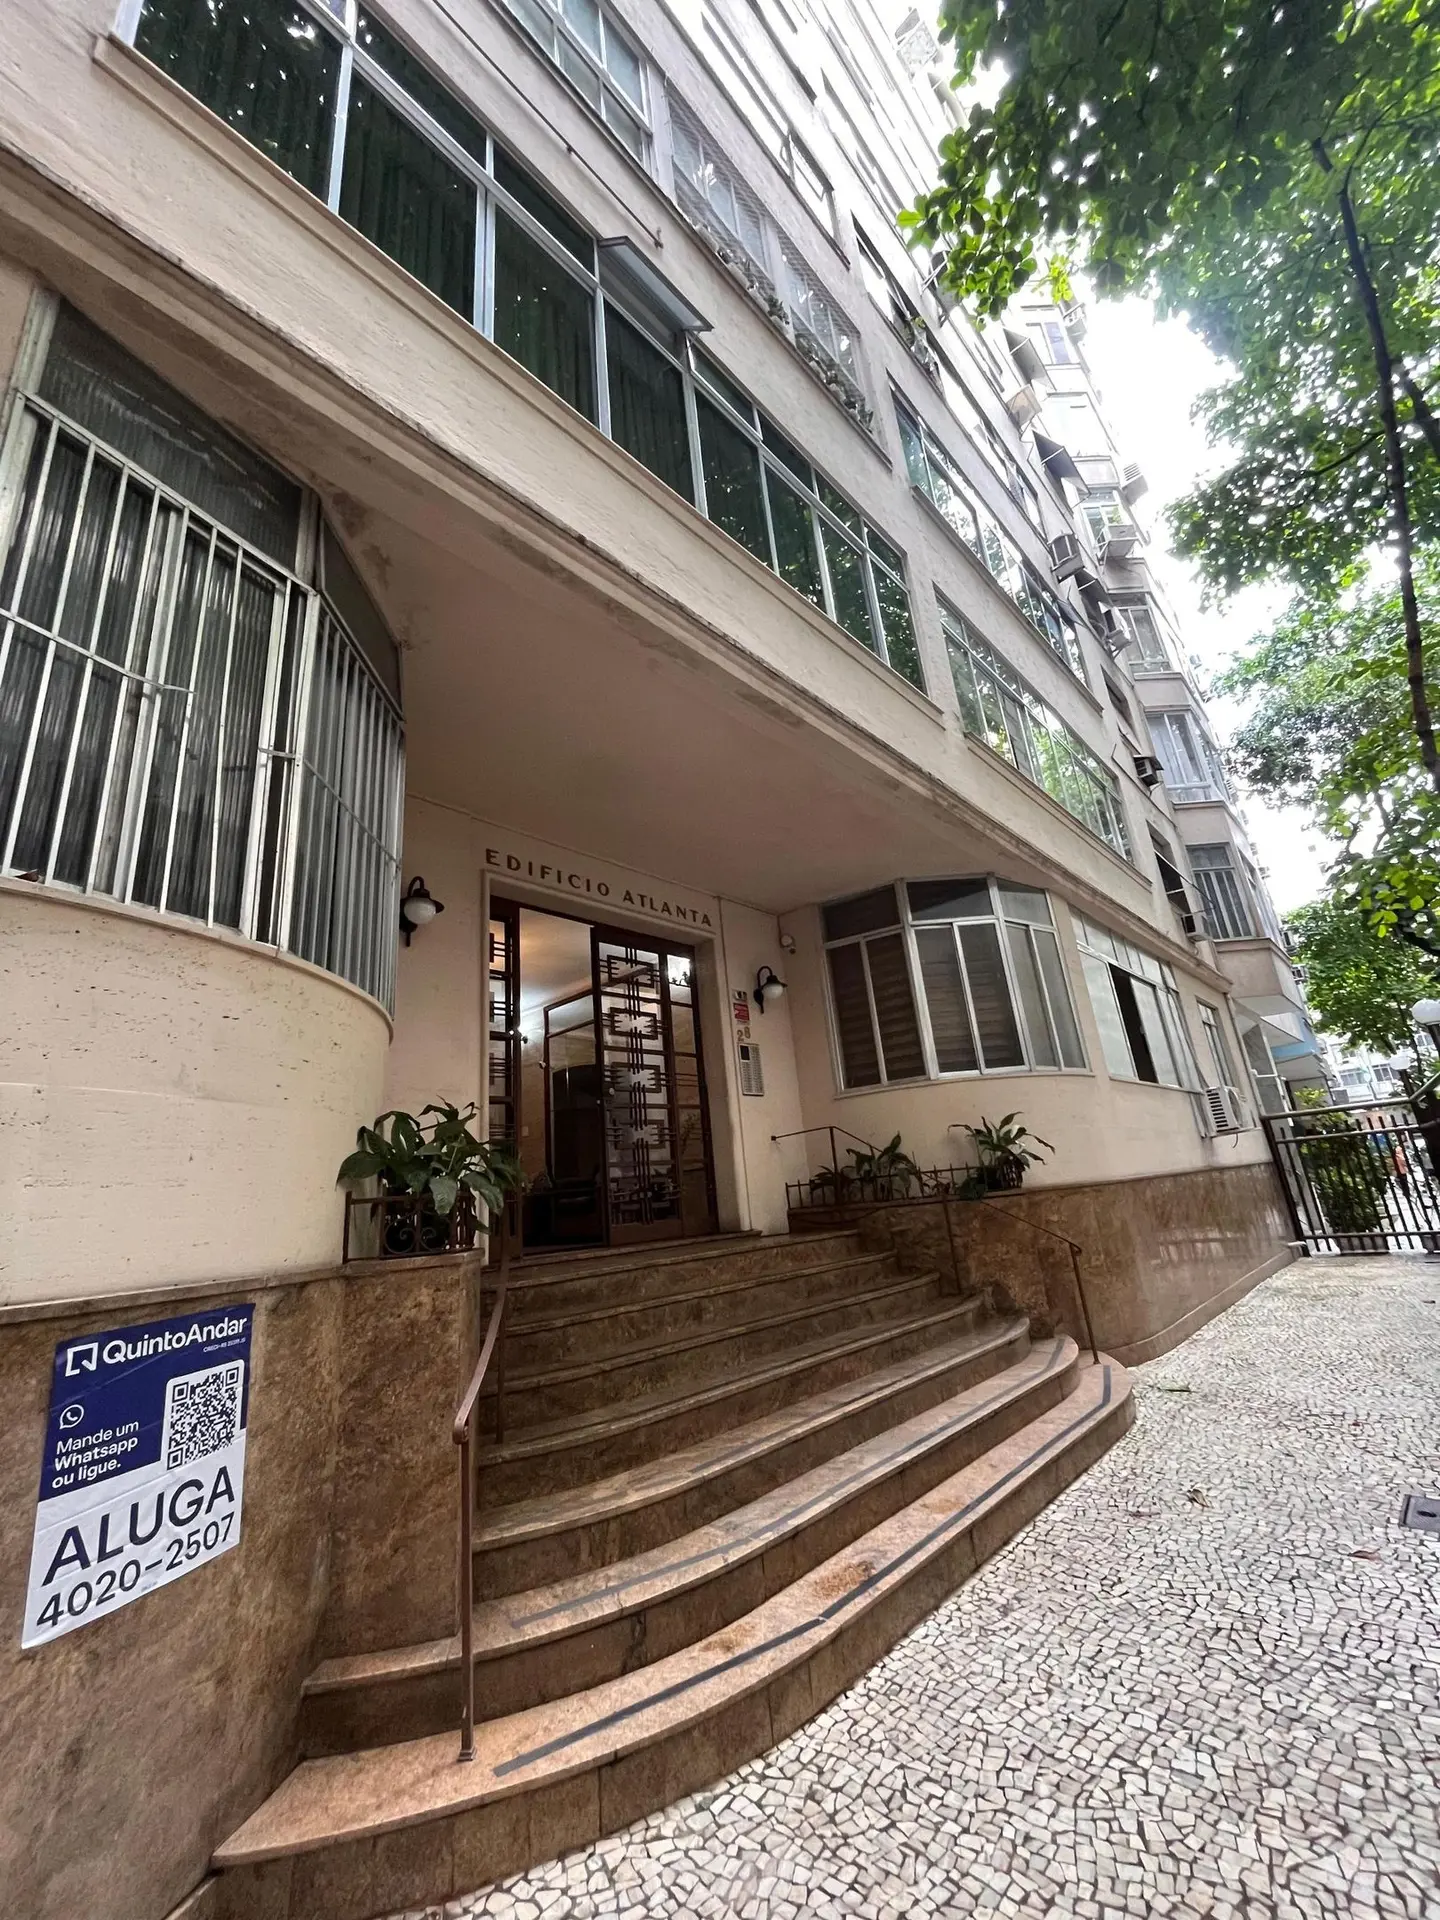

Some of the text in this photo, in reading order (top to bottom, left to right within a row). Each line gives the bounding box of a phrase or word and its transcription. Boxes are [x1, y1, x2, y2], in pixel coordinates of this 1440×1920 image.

[485, 848, 712, 927] EDIFICIO ATLANTA
[102, 1316, 248, 1366] QuintoAndar
[54, 1437, 139, 1472] Whatsapp
[56, 1421, 139, 1455] Mande um
[52, 1458, 121, 1489] ou ligue.
[41, 1465, 235, 1588] ALUGA
[36, 1511, 235, 1628] 4020-2507
